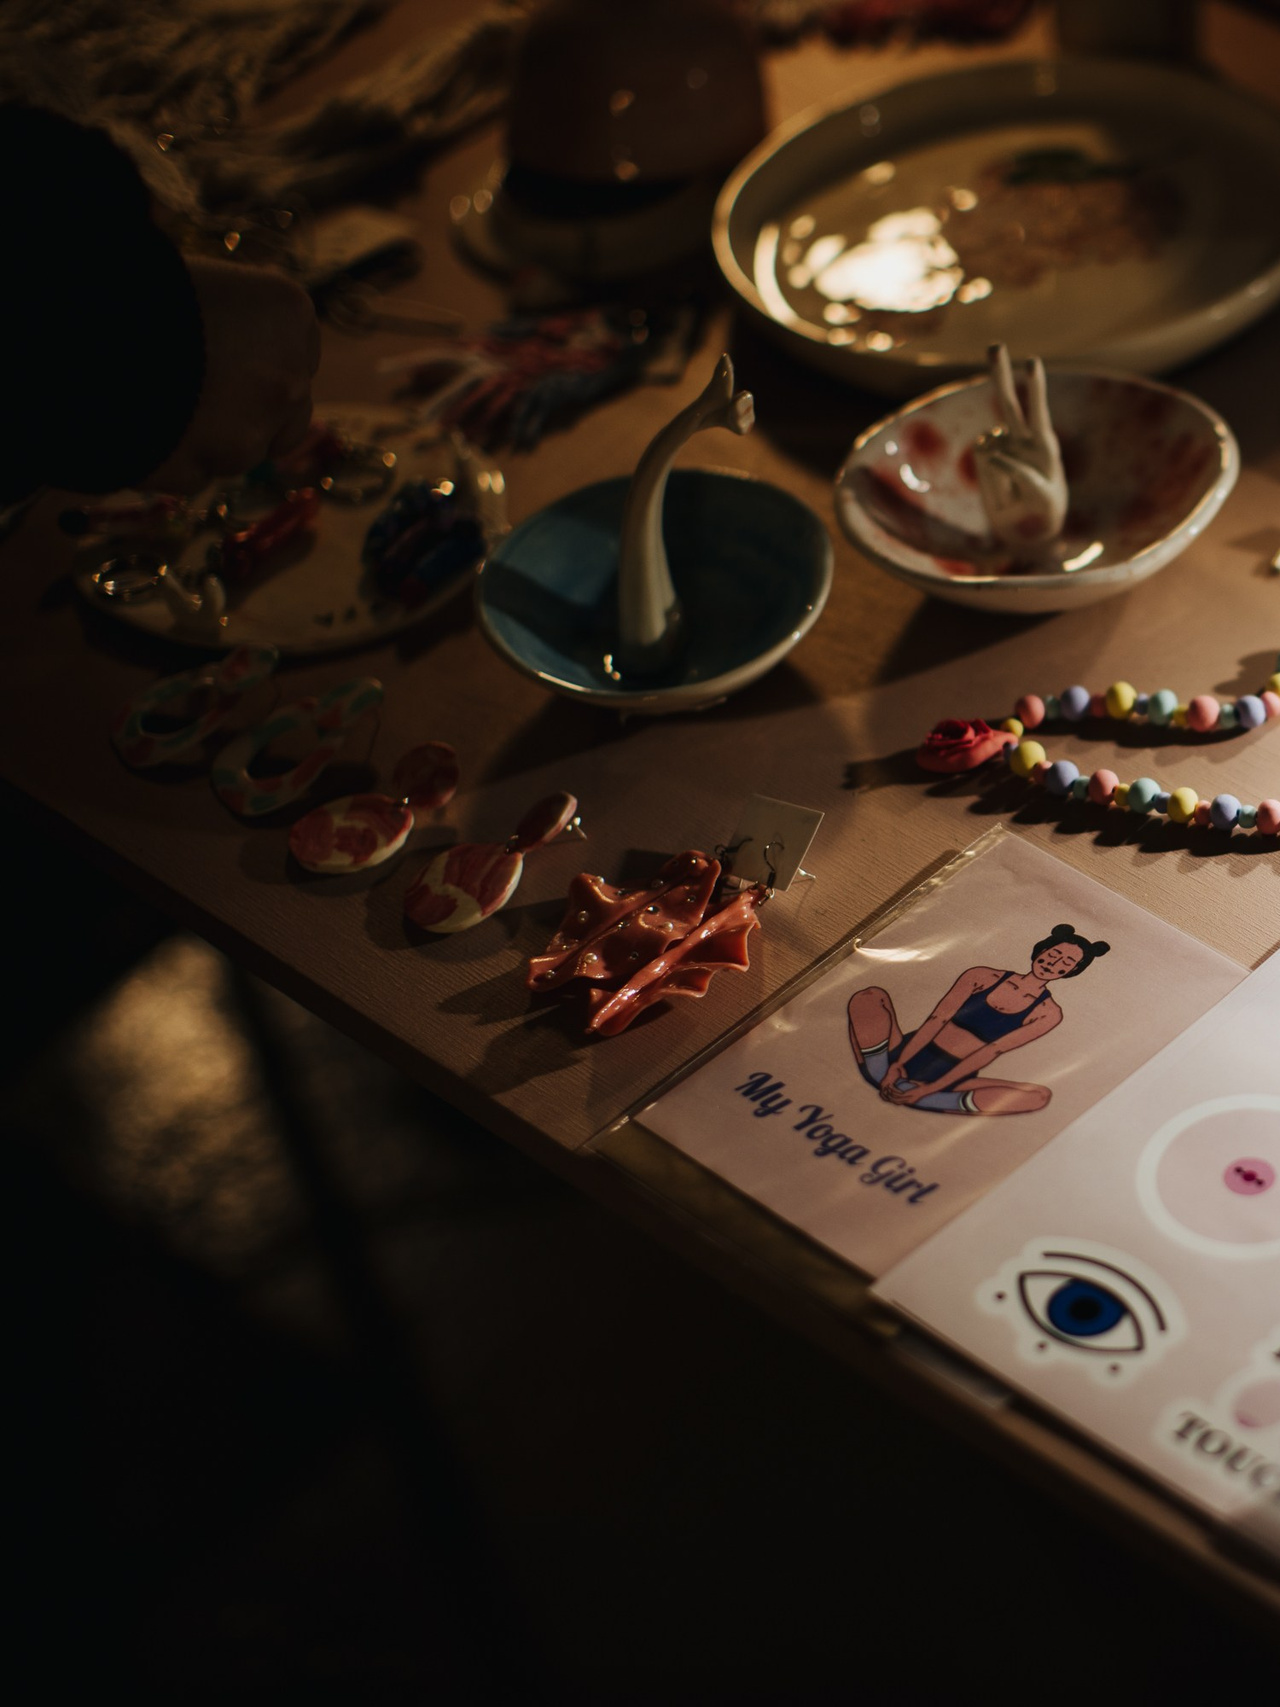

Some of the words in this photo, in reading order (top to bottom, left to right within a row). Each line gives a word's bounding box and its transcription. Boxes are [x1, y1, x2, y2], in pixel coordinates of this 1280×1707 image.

[734, 1071, 793, 1118] My
[793, 1104, 872, 1166] Yoga
[859, 1155, 941, 1205] Girl
